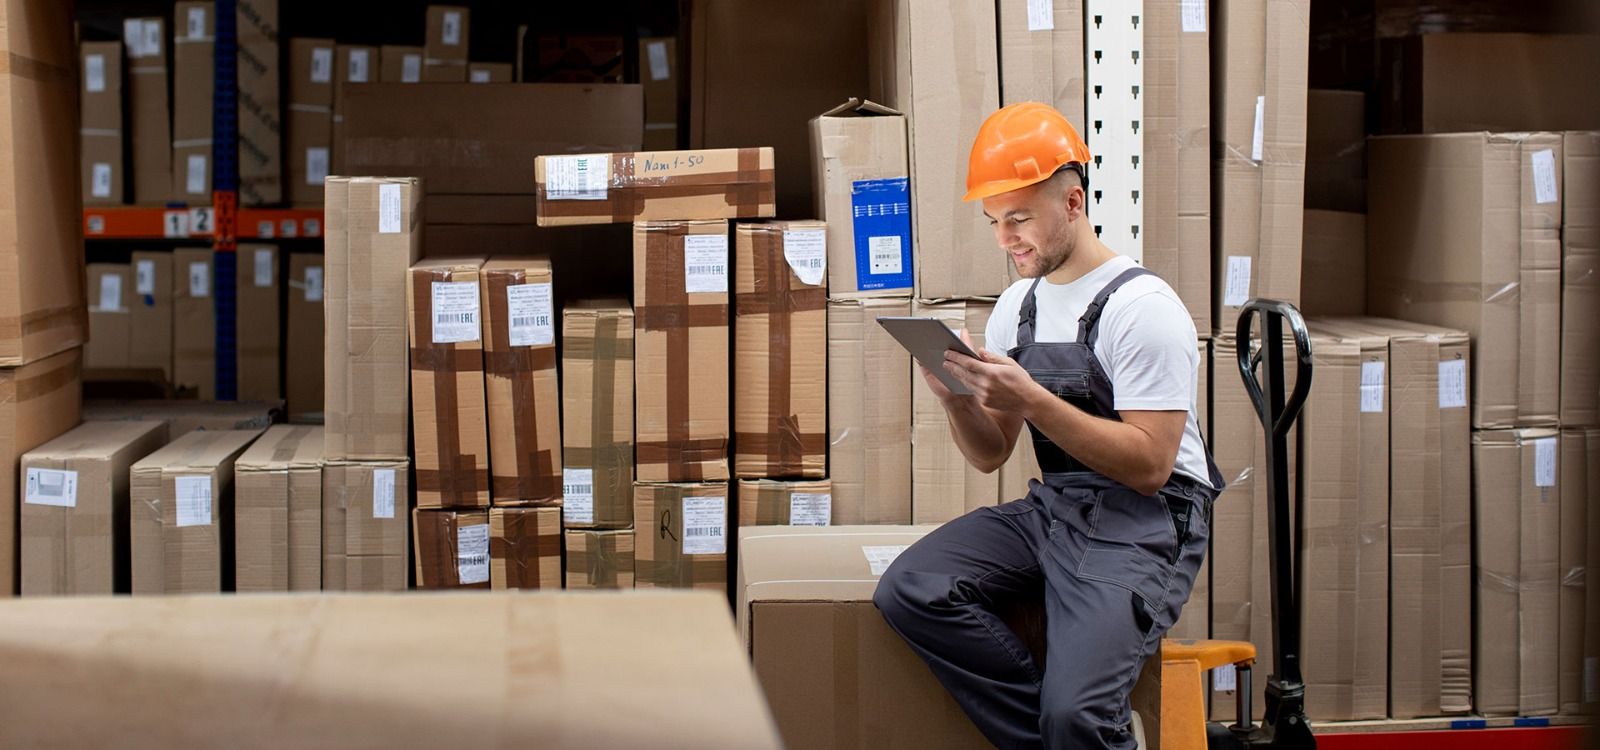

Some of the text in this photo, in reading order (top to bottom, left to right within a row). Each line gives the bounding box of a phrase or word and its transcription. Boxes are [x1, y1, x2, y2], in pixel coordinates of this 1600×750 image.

[171, 210, 208, 231] 1 2
[460, 312, 474, 324] EAC
[536, 315, 550, 327] EAC
[709, 526, 722, 537] EAC
